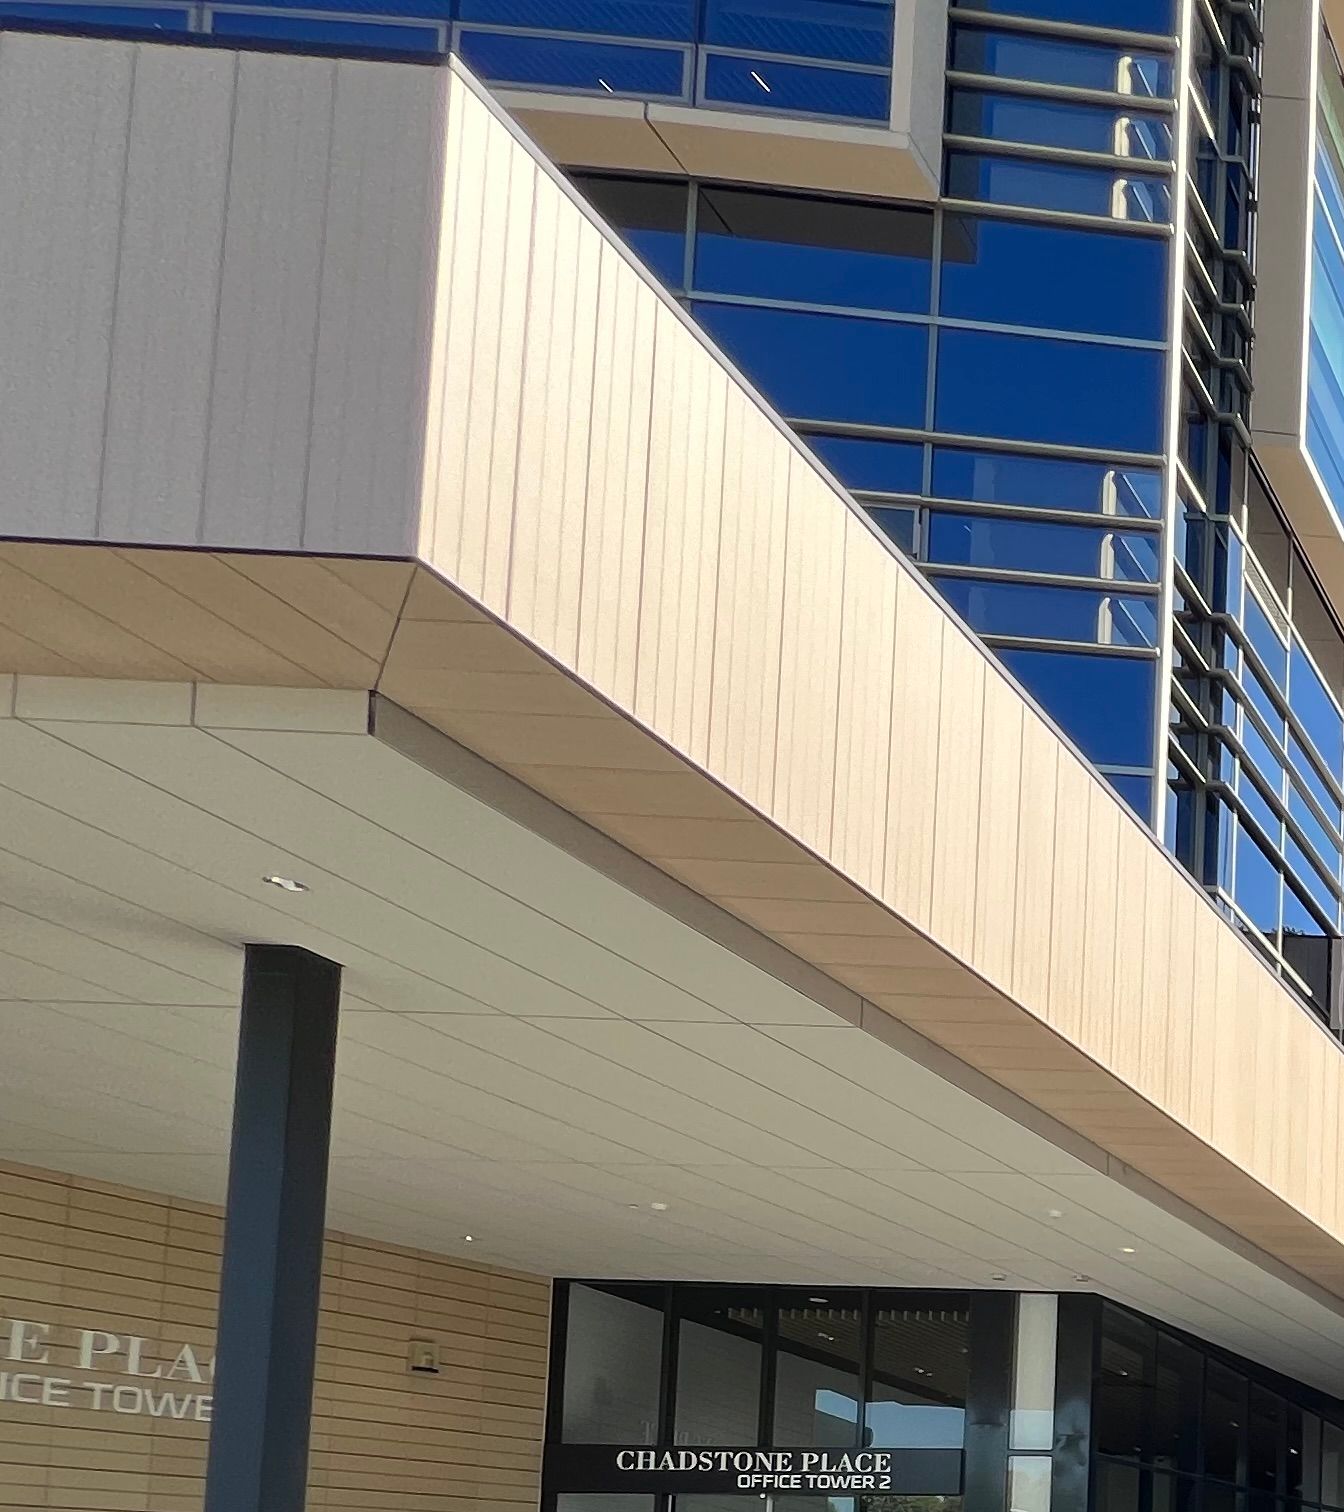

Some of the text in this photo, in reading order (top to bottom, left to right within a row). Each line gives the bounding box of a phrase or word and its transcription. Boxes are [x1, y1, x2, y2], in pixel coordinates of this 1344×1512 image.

[73, 1328, 216, 1384] PLA
[616, 1450, 892, 1473] CHADSTONE PLACE
[737, 1474, 892, 1490] OFFICE TOWER 2
